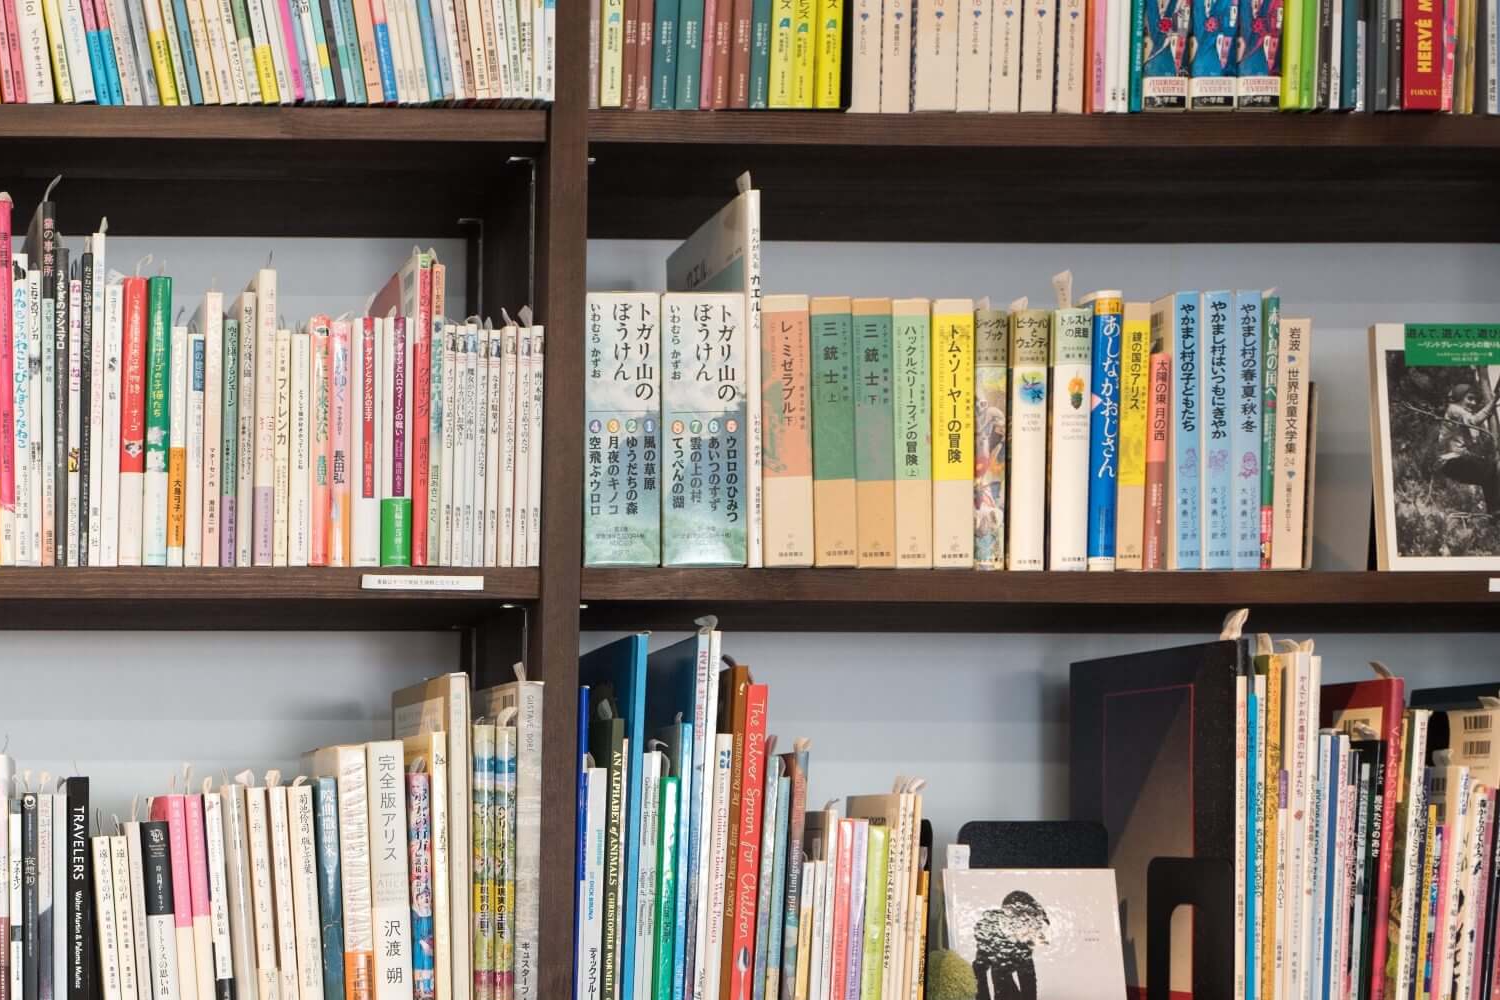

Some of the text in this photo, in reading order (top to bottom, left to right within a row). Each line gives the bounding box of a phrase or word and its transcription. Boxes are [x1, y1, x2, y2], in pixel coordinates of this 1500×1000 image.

[1417, 19, 1433, 73] HERVÉ
[590, 303, 602, 380] いわむら かずお
[613, 302, 654, 401] トガリ山の ぼうけん
[670, 304, 682, 381] いわむら かずお
[693, 303, 736, 402] トガリ山の ぼうけん
[782, 320, 795, 415] レ・ミゼラブル
[823, 321, 838, 386] 三銃士
[864, 324, 879, 387] 三銃士
[1180, 303, 1195, 432] やかまし村の子どもたち
[1210, 300, 1227, 440] やかまし村はいつもにぎやか
[1241, 303, 1257, 433] やかまし村の春・夏・秋・冬
[905, 326, 918, 467] ハックルベリー・フィンの冒険
[947, 324, 962, 464] トム・ソーヤーの冒険
[1098, 315, 1120, 479] あしながおじさん
[1284, 369, 1299, 455] 世界児童文学集
[589, 436, 602, 517] 空飛ぶウロロ
[607, 436, 619, 516] 月夜のキノコ
[626, 436, 638, 516] ゆうだちの森
[643, 436, 656, 491] 風の草原
[708, 436, 721, 512] あいつのすず
[726, 436, 739, 523] ウロロのひみつ
[73, 805, 85, 881] TRAVELERS
[607, 764, 620, 887] ALPHABET ANIMALS
[738, 865, 758, 941] Children
